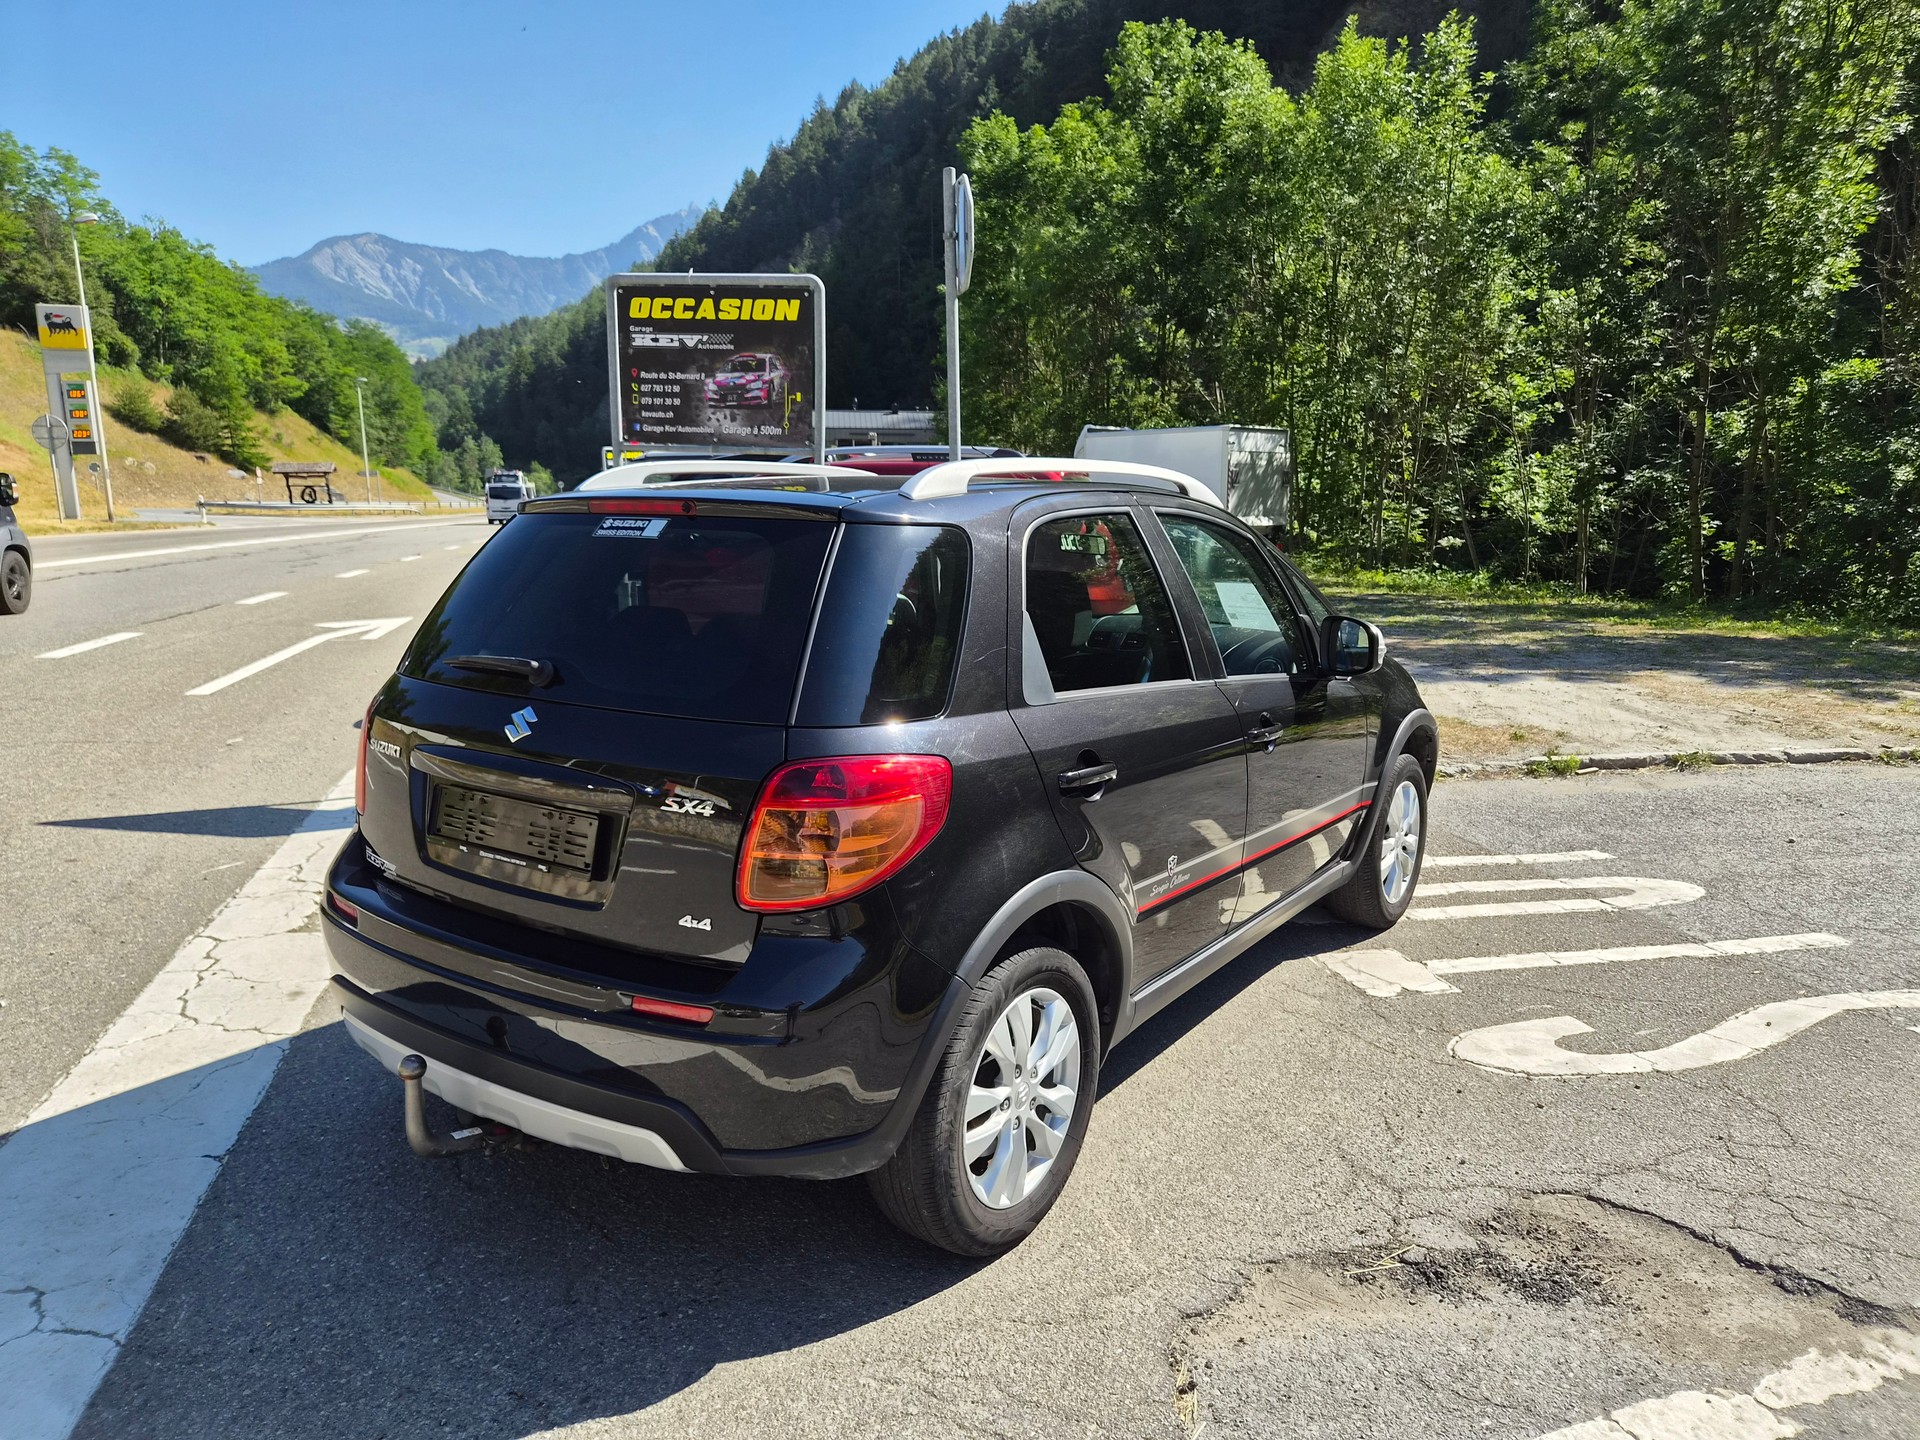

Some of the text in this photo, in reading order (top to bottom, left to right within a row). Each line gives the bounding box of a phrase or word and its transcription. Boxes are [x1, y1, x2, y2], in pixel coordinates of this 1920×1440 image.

[629, 297, 800, 321] OCCASION
[629, 325, 653, 333] Garage
[640, 371, 658, 379] Route
[668, 372, 701, 380] St-Bernard
[640, 384, 652, 392] 027
[653, 384, 663, 392] 783
[672, 385, 681, 393] 50
[641, 397, 652, 405] 079
[653, 397, 663, 405] 101
[672, 398, 681, 406] 50
[641, 410, 674, 418] kevauto.ch
[642, 424, 715, 434] Garage Kev'Automobiles
[722, 425, 782, 436] Garage à 500m
[612, 519, 650, 528] SUZUKI
[370, 738, 401, 758] SUZUKI
[660, 797, 715, 817] SX4
[678, 914, 712, 931] 4x4
